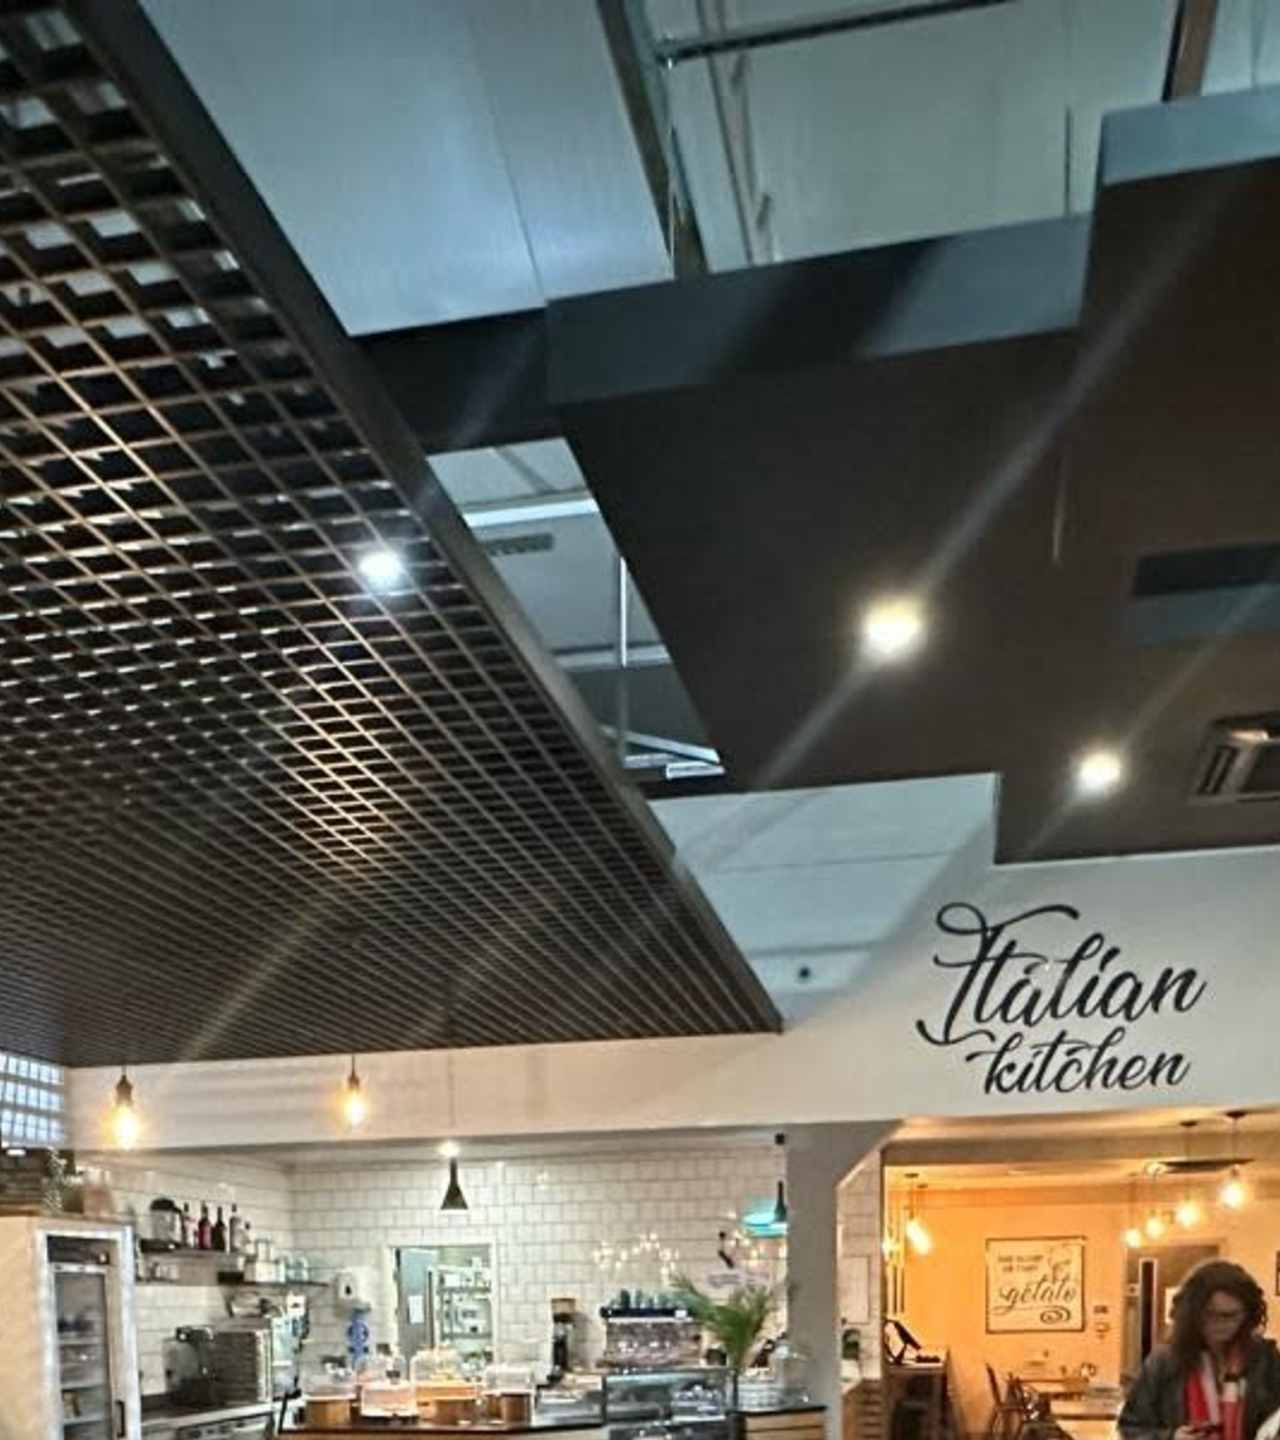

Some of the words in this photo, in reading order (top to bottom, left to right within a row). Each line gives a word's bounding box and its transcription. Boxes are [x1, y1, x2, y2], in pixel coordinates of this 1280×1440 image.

[916, 902, 1207, 1046] Italian
[965, 1026, 1190, 1094] kitchen
[992, 1273, 1077, 1316] gelato
